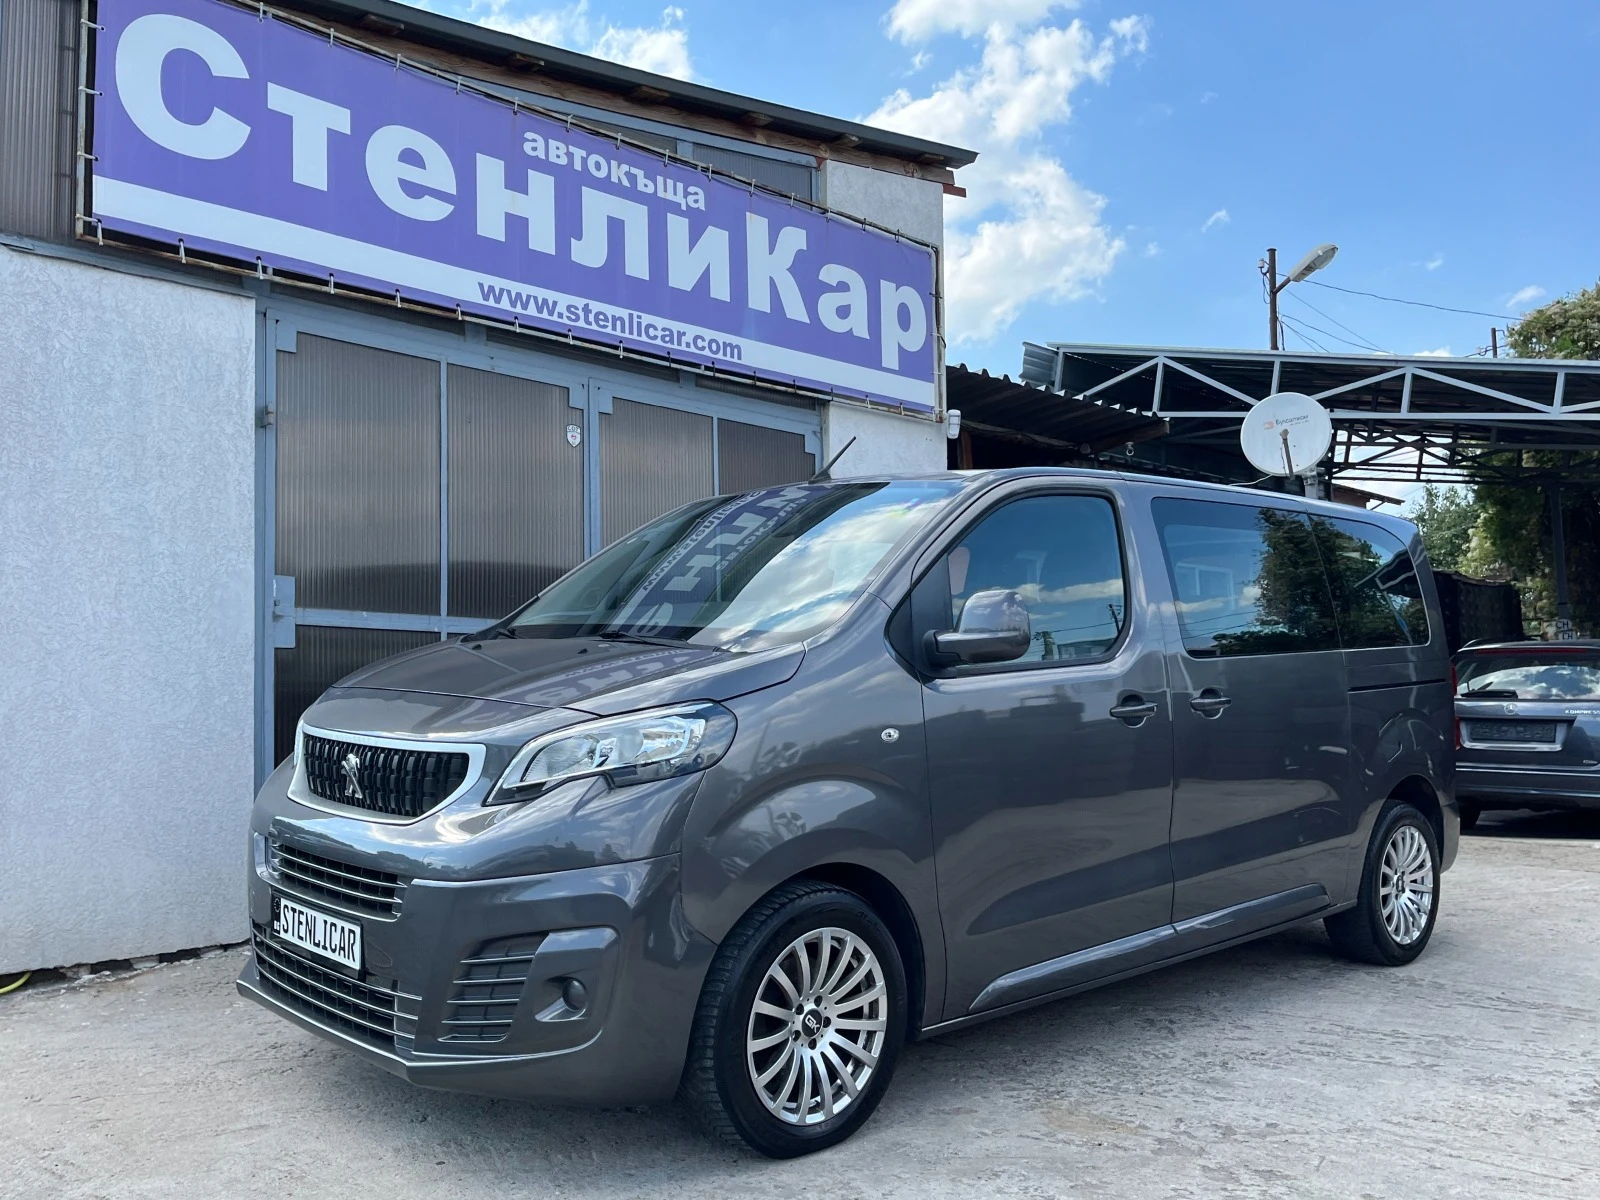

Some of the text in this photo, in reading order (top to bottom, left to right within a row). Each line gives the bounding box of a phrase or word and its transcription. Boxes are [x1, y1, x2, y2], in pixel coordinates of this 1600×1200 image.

[115, 13, 927, 370] СтенлиКар
[523, 131, 706, 211] автокъща
[477, 281, 742, 361] www.stenlicar.com
[282, 904, 356, 962] STENLICAR
